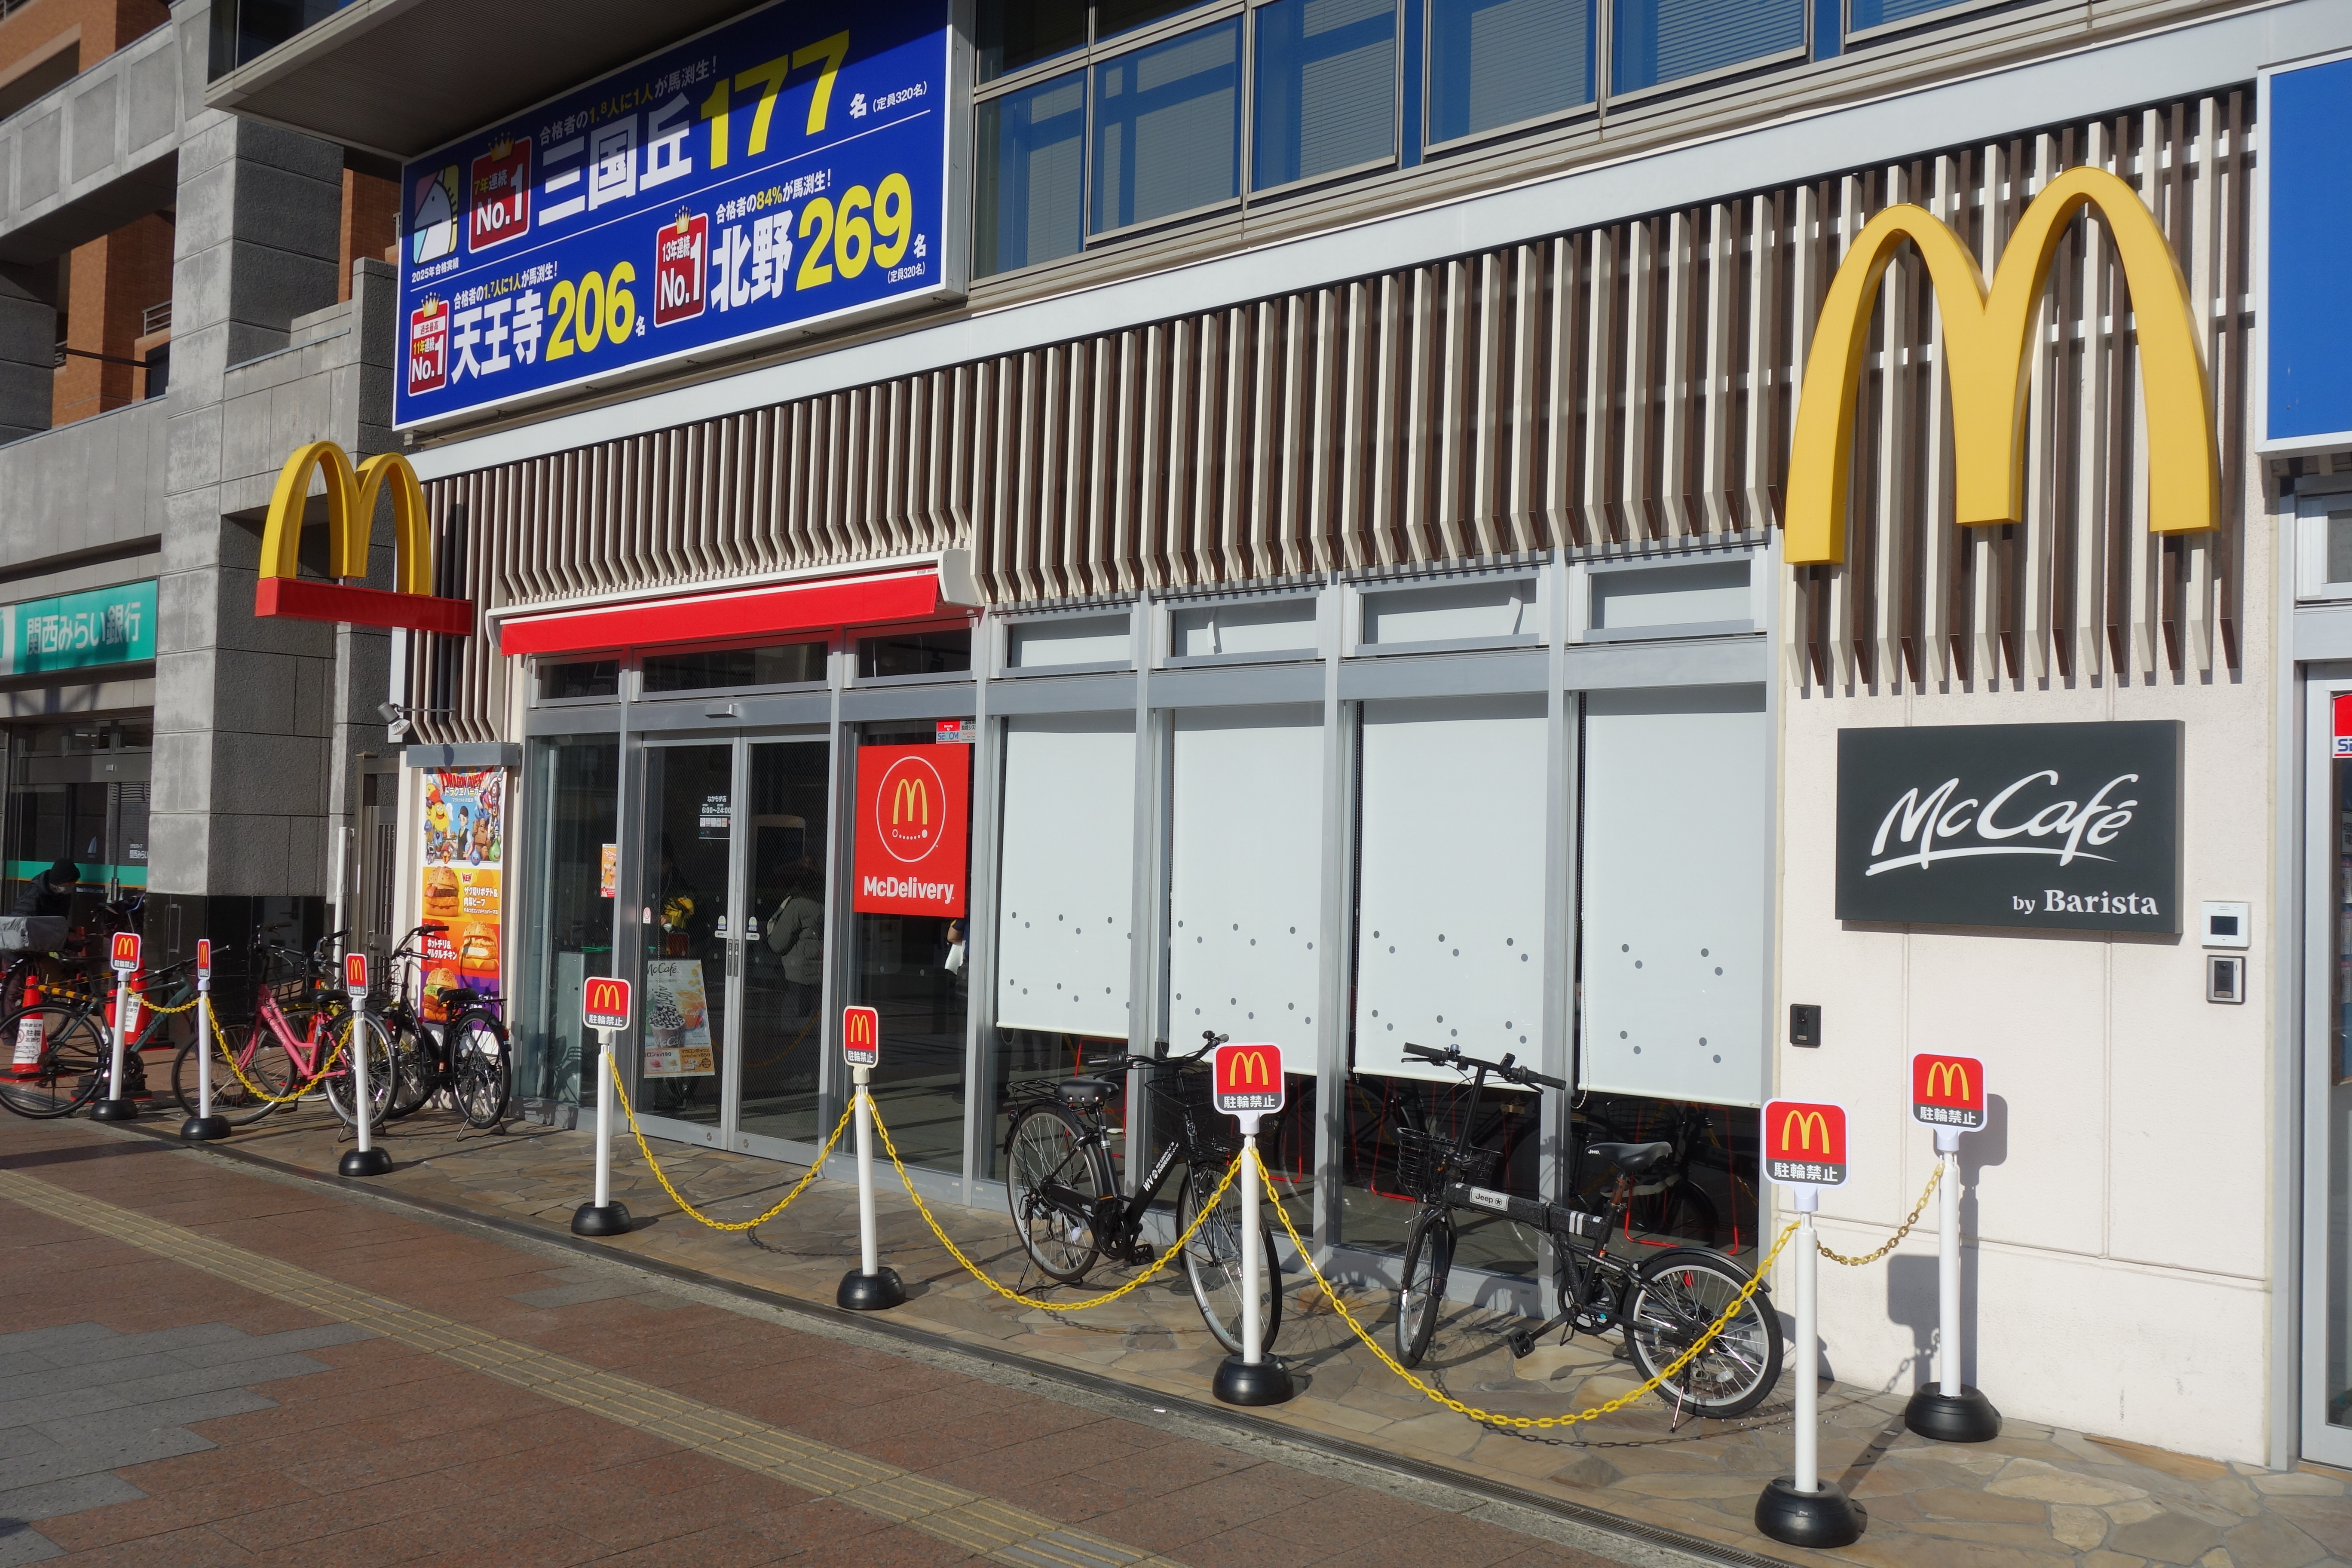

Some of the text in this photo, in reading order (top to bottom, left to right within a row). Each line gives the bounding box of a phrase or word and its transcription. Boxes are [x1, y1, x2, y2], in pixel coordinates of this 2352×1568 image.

[539, 29, 927, 226] 三国丘 177 名 (定員320名)
[474, 168, 507, 195] 7年連続
[476, 163, 523, 236] No.1
[711, 173, 926, 312] 北野 269 名
[412, 257, 459, 283] 2025年合格実績
[660, 232, 701, 311] No.1
[887, 264, 925, 284] (定員320名)
[420, 321, 439, 334] 過去最高
[451, 261, 645, 385] 天王寺 206 名
[411, 334, 444, 383] No.1
[27, 602, 141, 655] 関西みらい銀行
[444, 786, 484, 796] ドラクエバーガー
[1866, 769, 2138, 876] McCafé
[864, 876, 954, 904] McDelivery
[2012, 890, 2159, 916] by Barista
[588, 1014, 623, 1026] 駐輪禁止
[848, 1050, 873, 1063] 駐輪禁止
[1224, 1095, 1275, 1109] 駐輪禁止
[1920, 1106, 1976, 1125] 駐輪禁止
[1774, 1162, 1838, 1182] 駐輪禁止
[1475, 1193, 1493, 1204] Jeep
